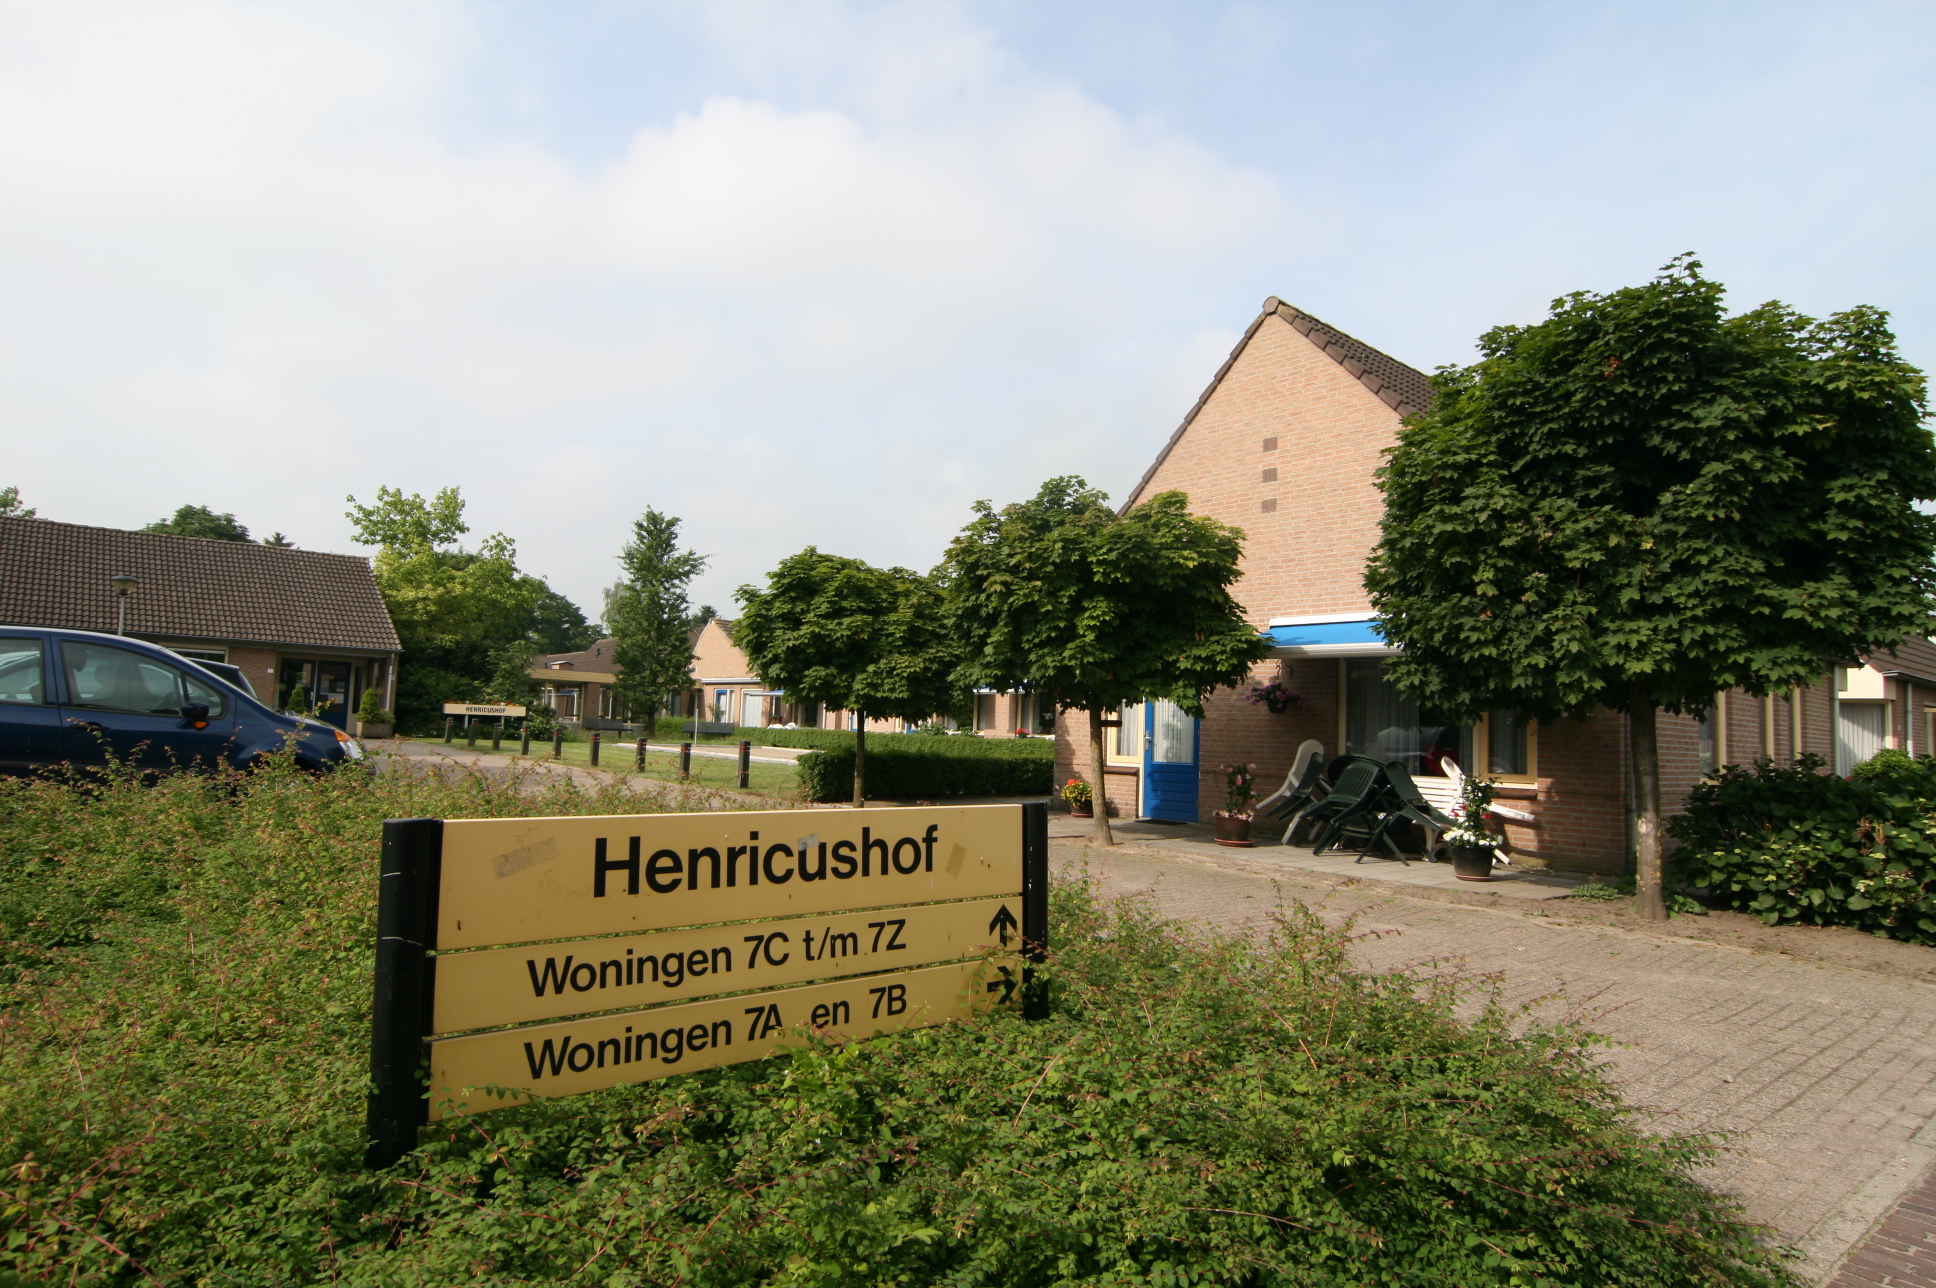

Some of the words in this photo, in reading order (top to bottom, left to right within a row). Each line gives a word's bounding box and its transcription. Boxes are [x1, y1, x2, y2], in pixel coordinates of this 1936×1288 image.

[465, 706, 507, 714] HENRICUSHOF
[593, 824, 938, 898] Henricushof
[526, 944, 732, 997] Woningen
[743, 931, 790, 969] 7C
[802, 926, 858, 961] t/m
[867, 919, 907, 953] 7Z
[523, 1019, 732, 1080] Woningen
[744, 1003, 783, 1042] 7A
[810, 1000, 850, 1029] en
[868, 983, 907, 1019] 7B
